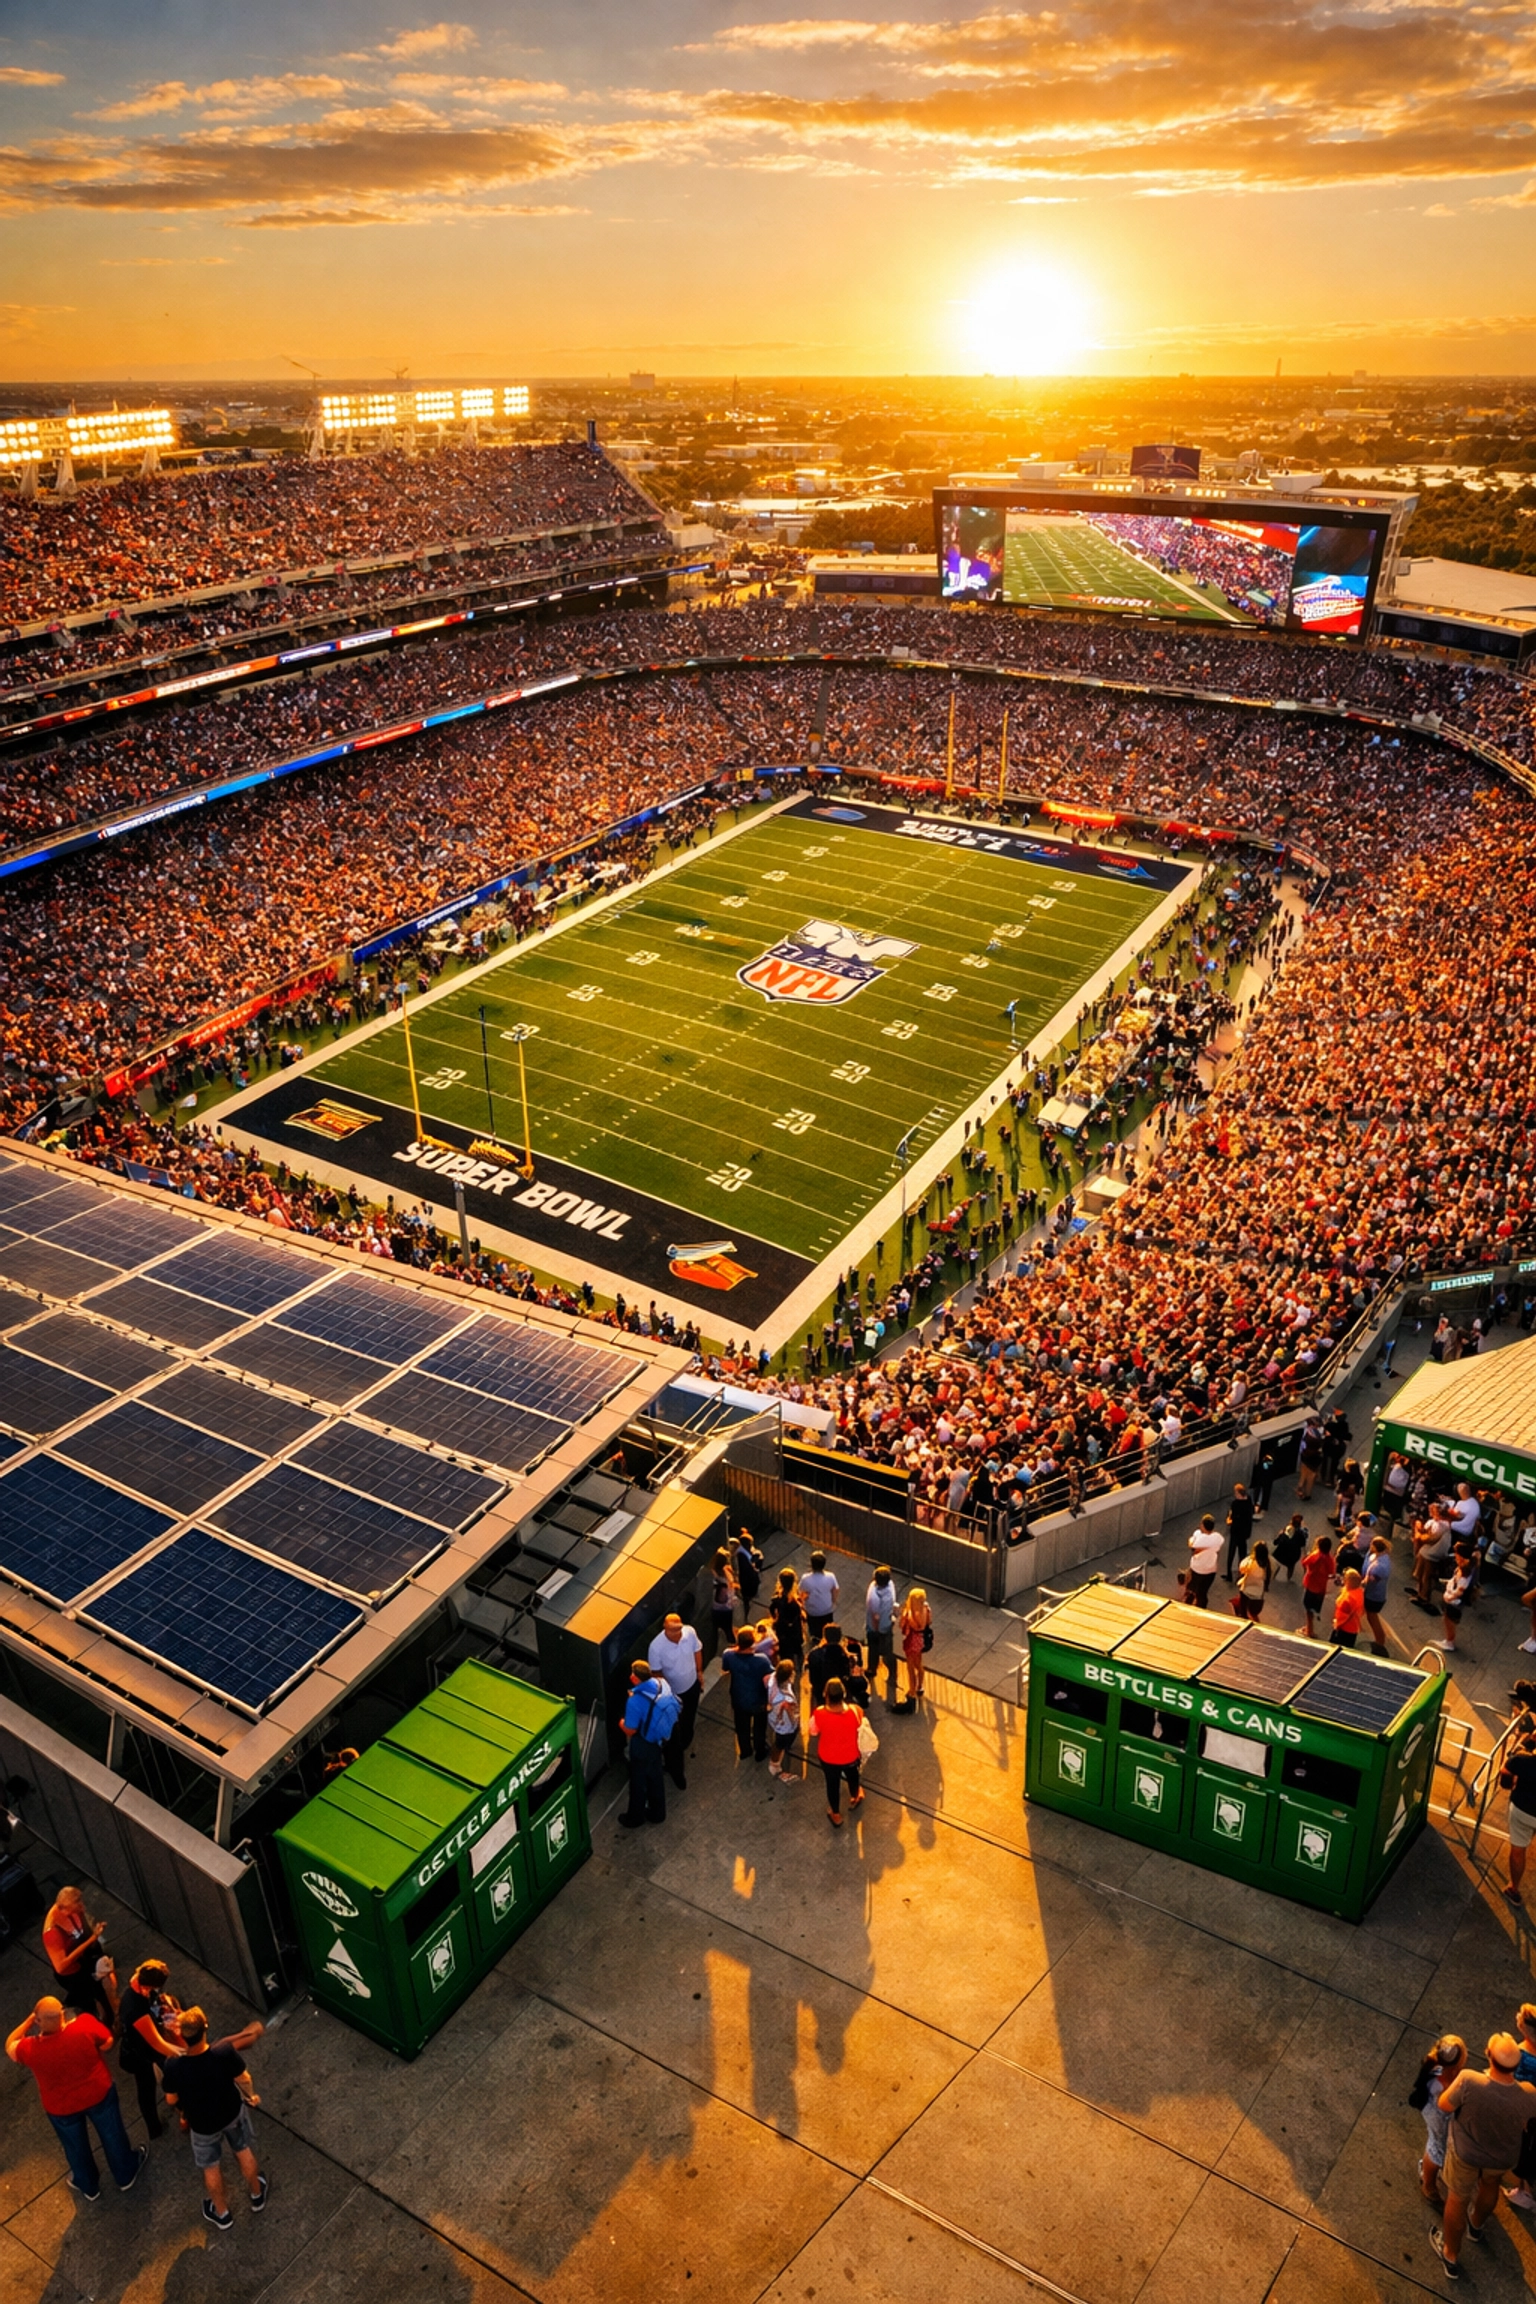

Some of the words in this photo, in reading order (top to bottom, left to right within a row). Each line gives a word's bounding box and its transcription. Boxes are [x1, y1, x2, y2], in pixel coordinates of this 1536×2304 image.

[750, 959, 842, 1000] NFL
[391, 1141, 520, 1195] SUPER
[512, 1181, 633, 1241] BOWL
[1084, 1663, 1194, 1710] BETCLES
[1201, 1699, 1219, 1719] &
[1227, 1707, 1302, 1743] CANS
